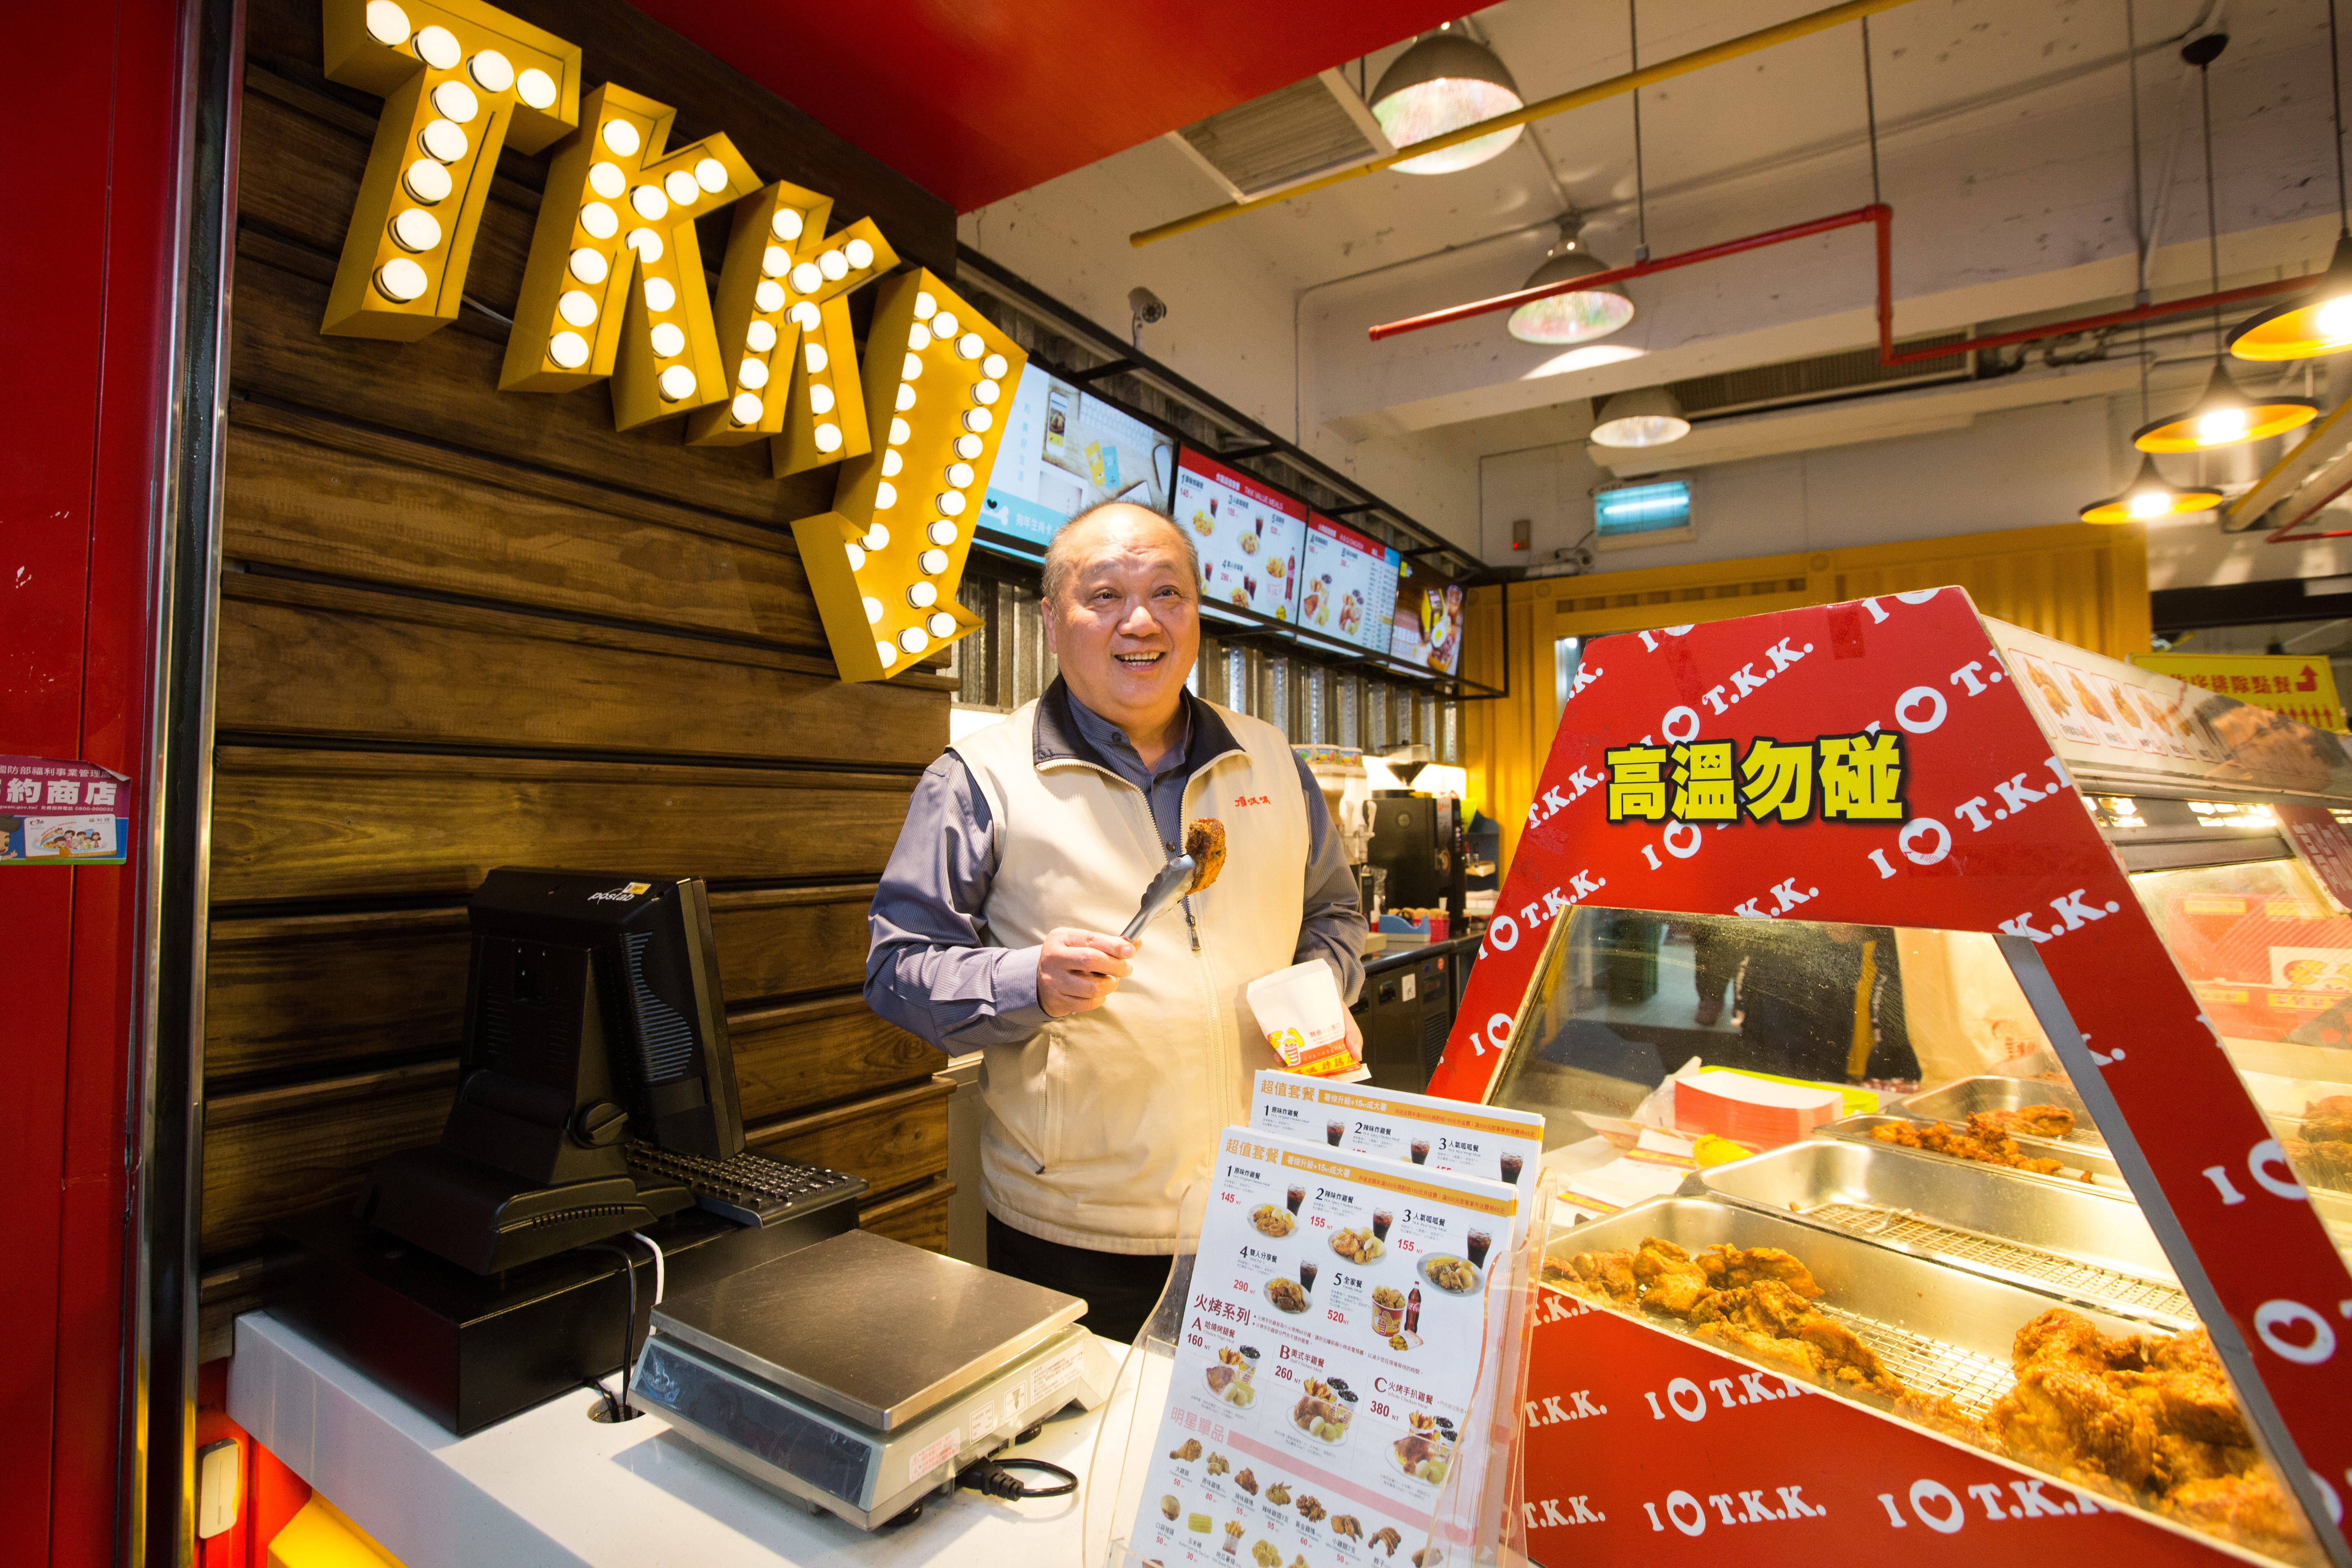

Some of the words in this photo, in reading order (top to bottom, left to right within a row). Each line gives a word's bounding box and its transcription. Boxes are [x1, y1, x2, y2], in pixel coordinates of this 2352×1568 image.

[1702, 637, 1813, 715] T.K.K.
[1607, 734, 1904, 821] 高溫勿碰
[0, 777, 117, 806] 約商店
[587, 890, 635, 903] poslab
[1261, 1080, 1315, 1102] 超值套餐
[1264, 1105, 1269, 1116] 1
[1354, 1122, 1363, 1134] 2
[1226, 1138, 1279, 1164] 超值套餐
[1439, 1138, 1446, 1150] 3
[1449, 1140, 1479, 1152] 人氣呱呱餐
[1227, 1165, 1232, 1177] 1
[1221, 1192, 1235, 1203] 145
[1315, 1188, 1324, 1200] 2
[1310, 1216, 1326, 1228] 155
[1403, 1209, 1411, 1223] 3
[1413, 1212, 1446, 1227] 人氣呱呱餐
[1397, 1238, 1415, 1252] 155
[1240, 1246, 1248, 1258] 4
[1250, 1248, 1277, 1263] 雙人分享餐
[1233, 1279, 1249, 1292] 290
[1333, 1273, 1342, 1286] 5
[1344, 1276, 1363, 1288] 全家餐
[1194, 1294, 1251, 1326] 火烤系列
[1327, 1310, 1344, 1323] 520
[1192, 1317, 1202, 1331] A
[1187, 1333, 1203, 1347] 160
[1279, 1344, 1290, 1360] B
[1291, 1348, 1325, 1368] 美式半雞餐
[1298, 1360, 1312, 1370] Chicken
[1275, 1365, 1292, 1381] 260
[1374, 1377, 1387, 1393] C
[1388, 1381, 1433, 1405] 火烤手扒雞餐
[1387, 1392, 1400, 1400] Whole
[1401, 1395, 1417, 1405] Chicken
[1370, 1401, 1390, 1417] 380
[1644, 1392, 1666, 1420] I
[1170, 1406, 1224, 1443] 明星單品
[1206, 1492, 1212, 1501] 80
[1236, 1507, 1243, 1515] 55
[1643, 1502, 1664, 1532] I
[1709, 1485, 1827, 1525] T.K.K.
[1878, 1493, 1907, 1528] I
[1267, 1521, 1274, 1530] 55
[1156, 1536, 1163, 1544] 50
[1301, 1537, 1307, 1546] 60
[1186, 1552, 1193, 1560] 30
[1337, 1554, 1344, 1563] 50
